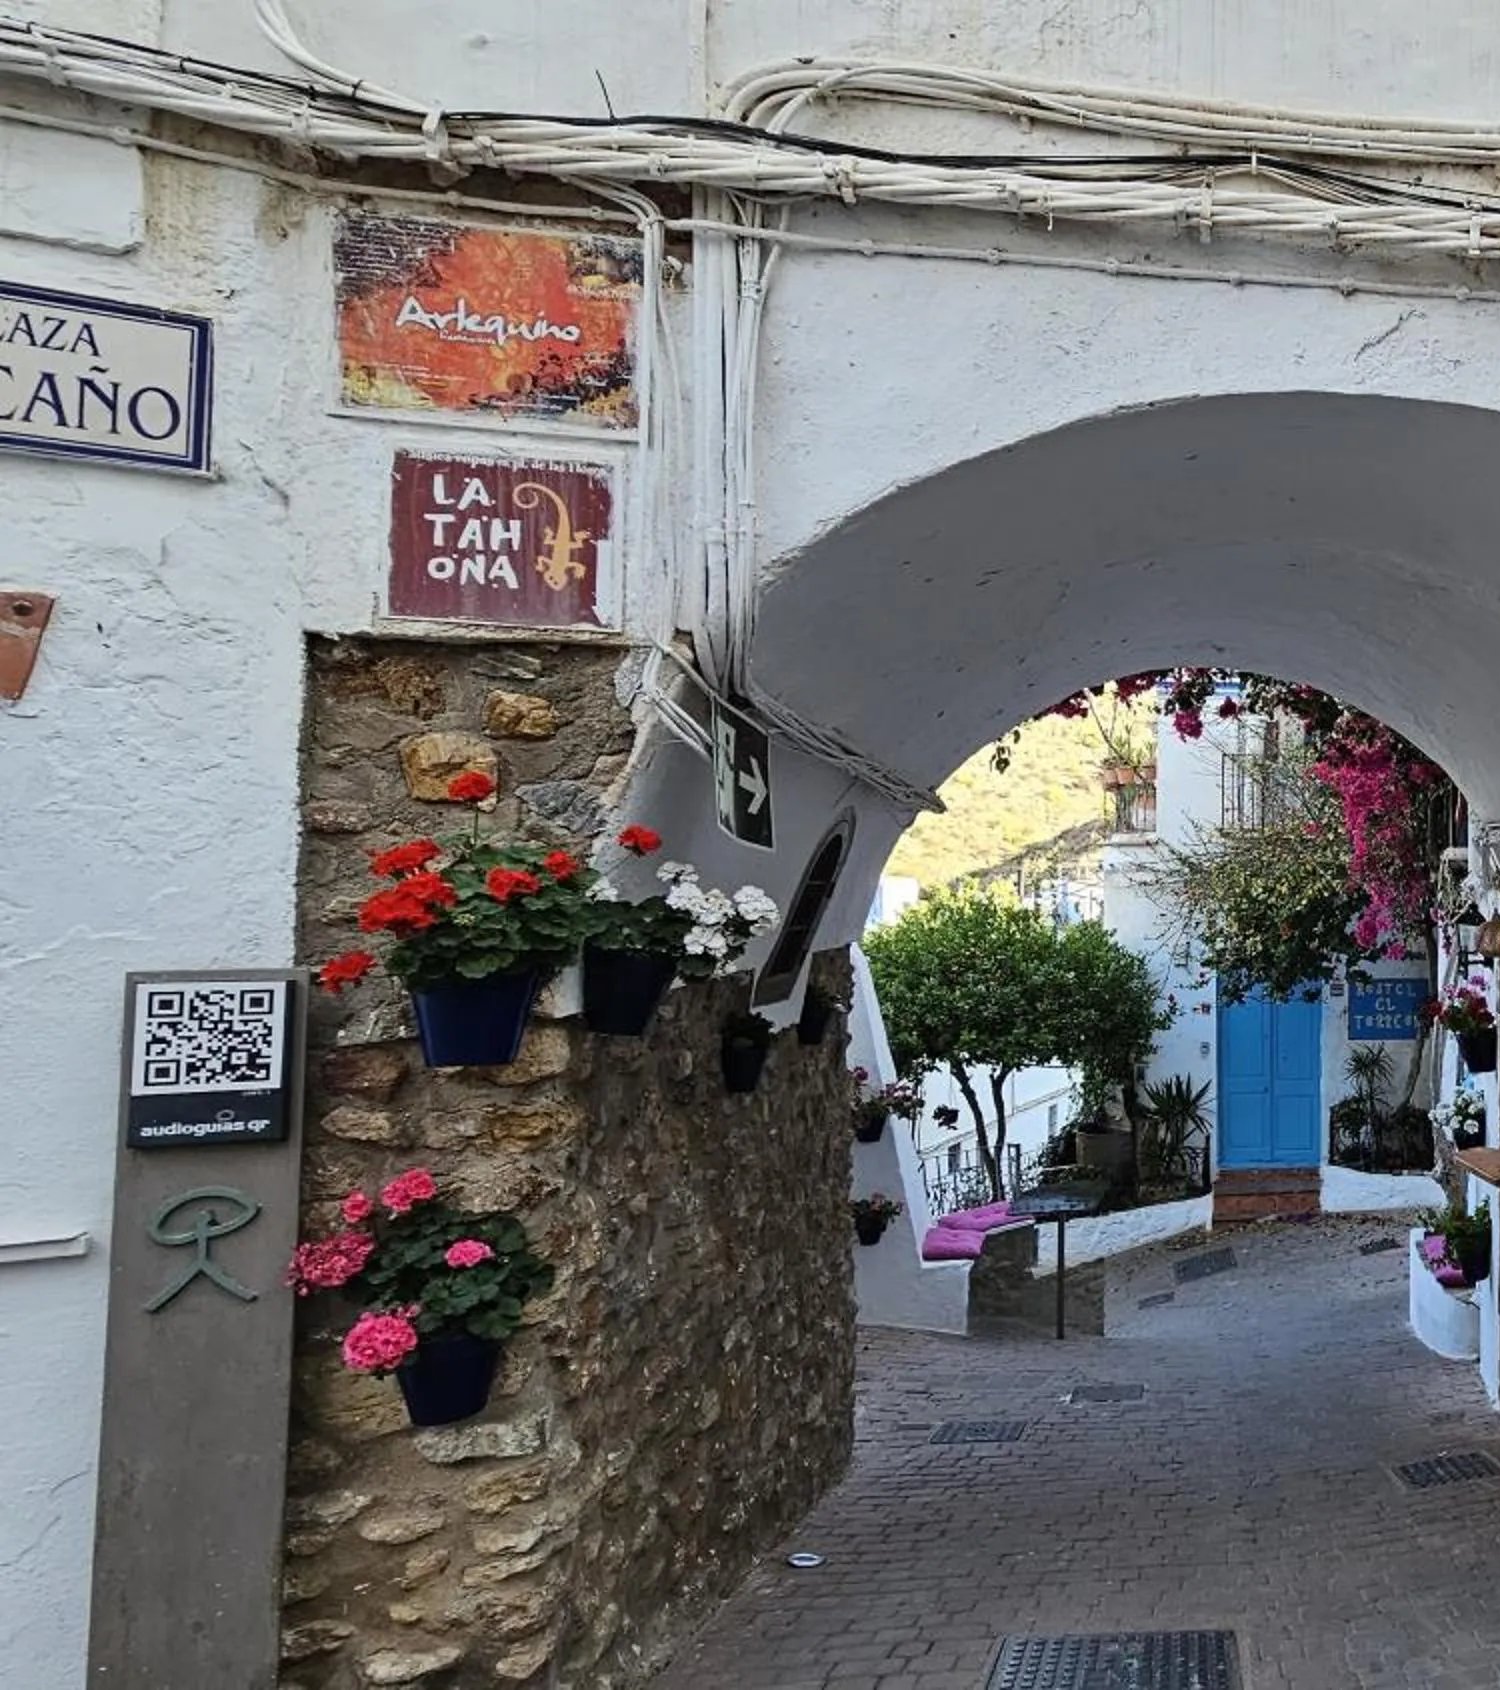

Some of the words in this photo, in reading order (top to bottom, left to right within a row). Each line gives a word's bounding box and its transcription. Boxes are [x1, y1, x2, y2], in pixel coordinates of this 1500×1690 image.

[0, 312, 100, 356] AZA
[433, 473, 491, 510] LA
[423, 513, 521, 551] TAH
[427, 554, 519, 589] ONA
